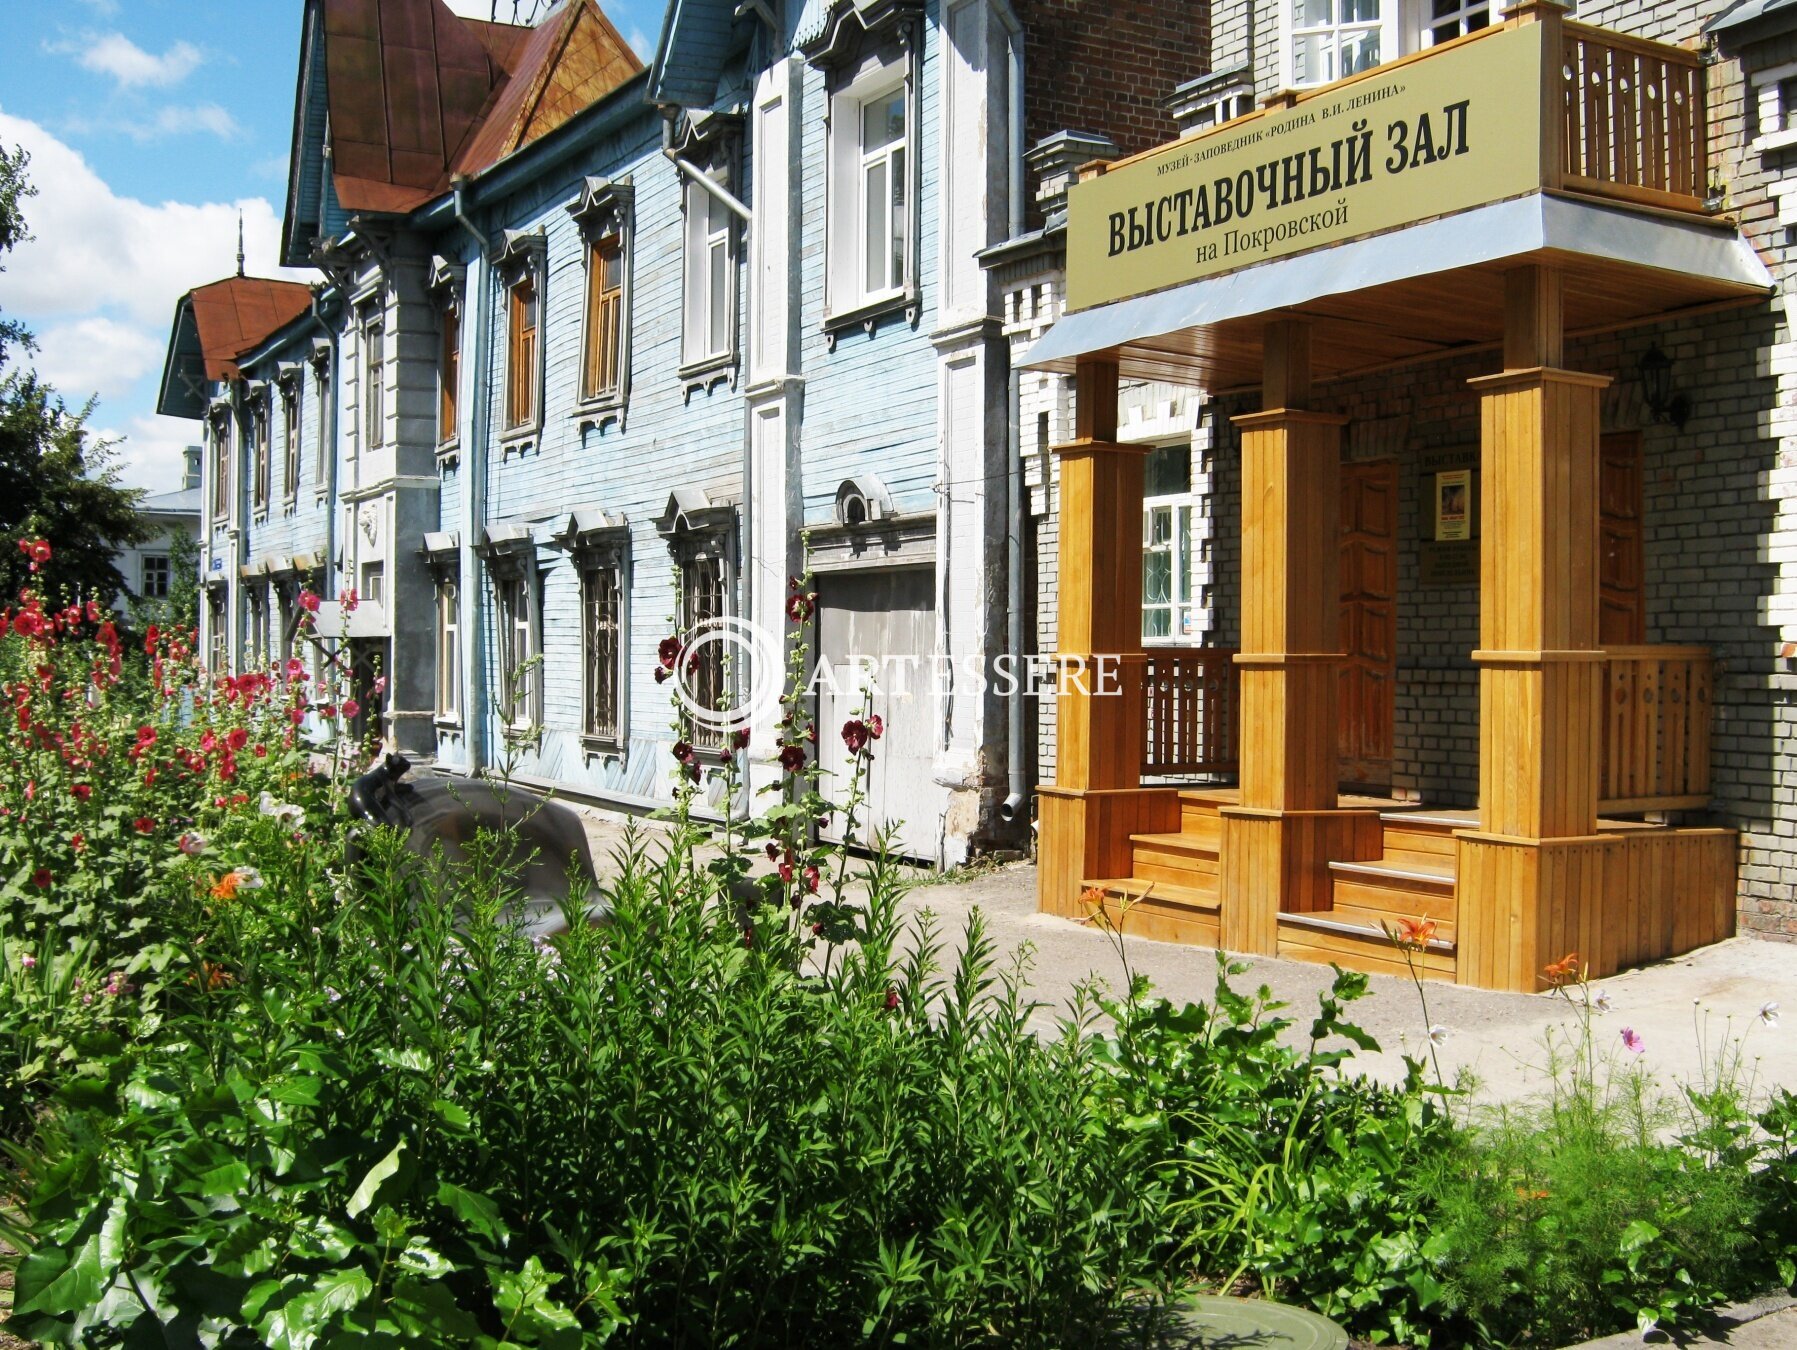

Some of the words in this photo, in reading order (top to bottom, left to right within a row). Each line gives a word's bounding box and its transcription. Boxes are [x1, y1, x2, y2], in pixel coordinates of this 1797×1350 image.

[1156, 130, 1264, 176] МУЗЕЙ-ЗАПОВЕДНИК
[1265, 113, 1316, 138] «РОДИНА
[1322, 103, 1345, 120] В.И.
[1346, 84, 1406, 111] ЛЕНИНА»
[1107, 119, 1374, 258] ВЫСТАВОЧНЫЙ
[1386, 99, 1470, 175] ЗАЛ
[1196, 242, 1218, 264] на
[1223, 197, 1350, 257] Покровской
[1424, 450, 1480, 467] ВЫСТАВК
